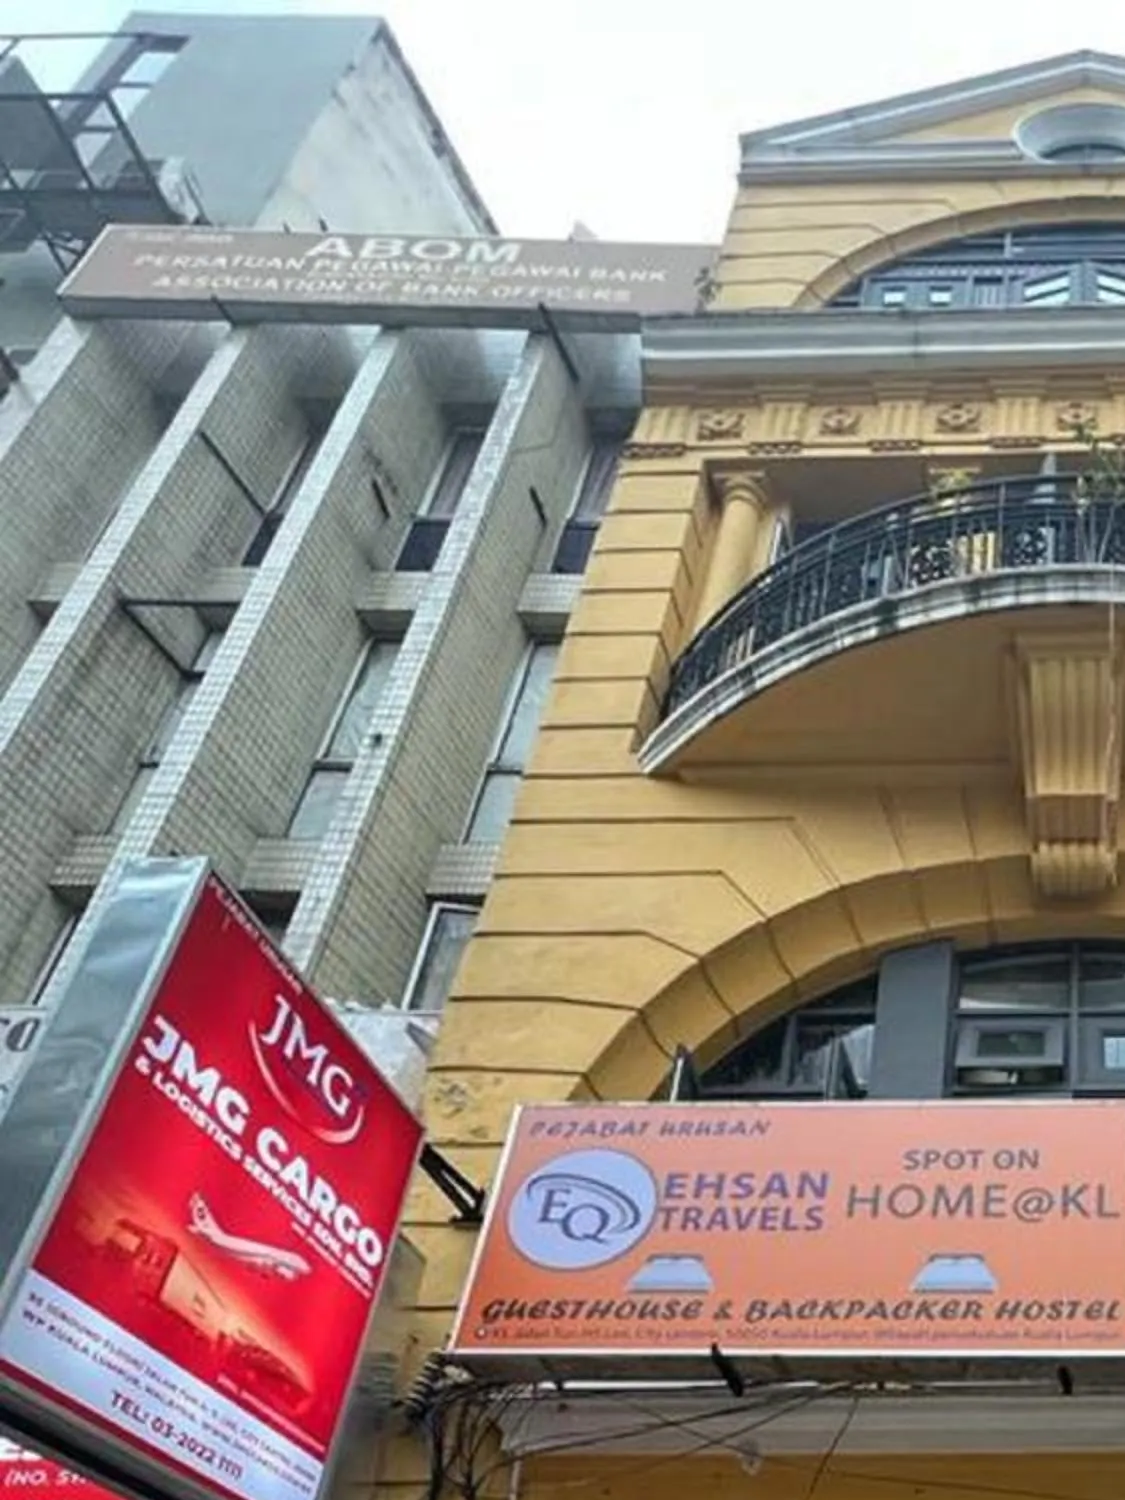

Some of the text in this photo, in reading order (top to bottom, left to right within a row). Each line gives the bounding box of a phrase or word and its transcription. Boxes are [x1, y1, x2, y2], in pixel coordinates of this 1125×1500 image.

[304, 237, 522, 264] ABOM
[260, 993, 354, 1117] JMG
[152, 1072, 243, 1161] LOGISTICS
[529, 1119, 771, 1138] PEJABAT URUSAN
[142, 1014, 250, 1136] JMG
[256, 1126, 383, 1267] CARGO
[903, 1149, 1041, 1171] SPOT ON
[664, 1171, 829, 1200] EHSAN
[847, 1184, 1120, 1223] HOME@KL
[659, 1206, 826, 1232] TRAVELS
[482, 1299, 703, 1324] GUESTHOUSE
[713, 1300, 732, 1320] &
[745, 1299, 984, 1323] BACKPACKER
[995, 1300, 1121, 1321] HOSTEL
[111, 1389, 150, 1425] TEL:
[151, 1416, 217, 1464] 03-2022
